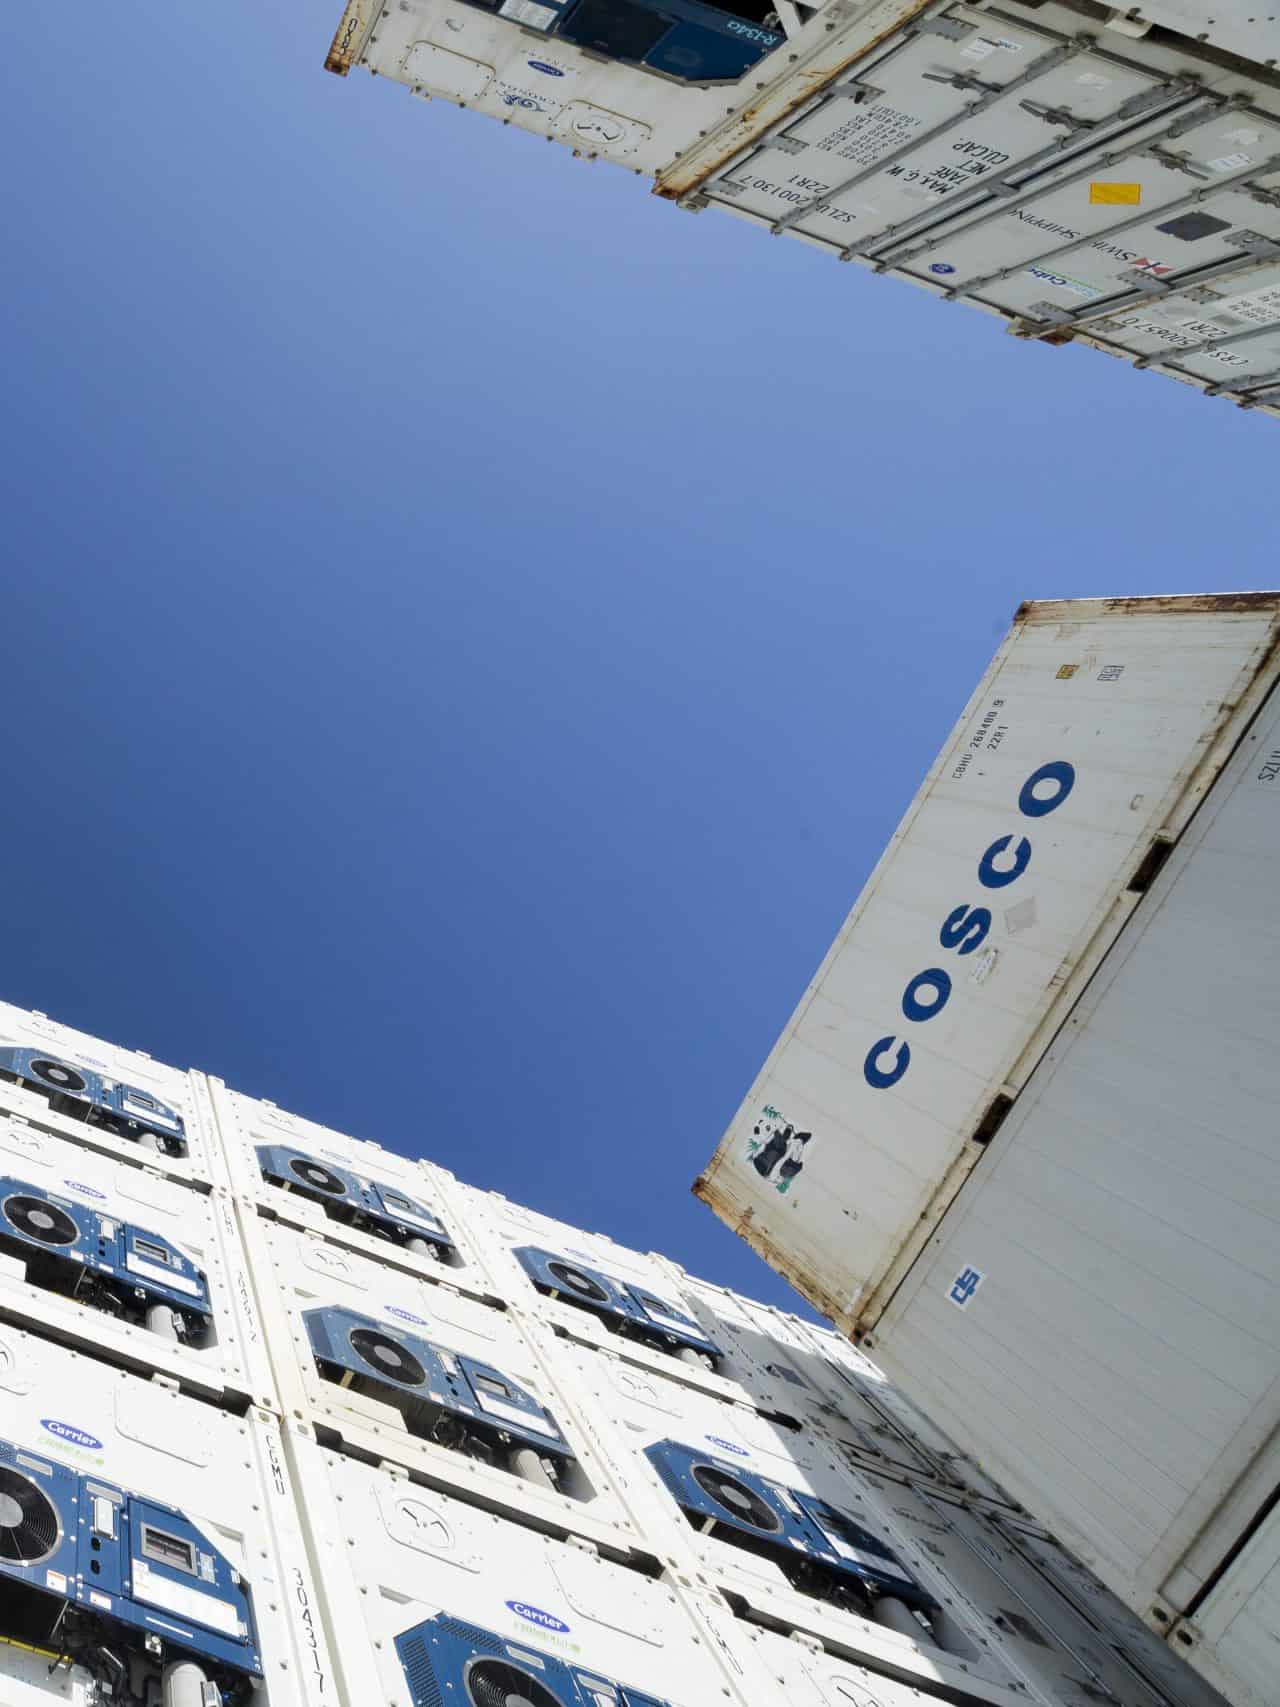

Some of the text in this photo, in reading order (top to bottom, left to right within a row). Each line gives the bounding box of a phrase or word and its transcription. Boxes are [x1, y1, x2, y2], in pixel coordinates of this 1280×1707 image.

[929, 165, 971, 185] TARE
[956, 159, 992, 175] NET
[752, 179, 810, 205] 200130
[788, 174, 830, 194] 22R1
[1183, 320, 1228, 338] 22R1
[1209, 351, 1249, 367] CRS
[863, 760, 1076, 1090] COSCO
[46, 1421, 98, 1446] Carrier
[513, 1603, 563, 1630] Carrier
